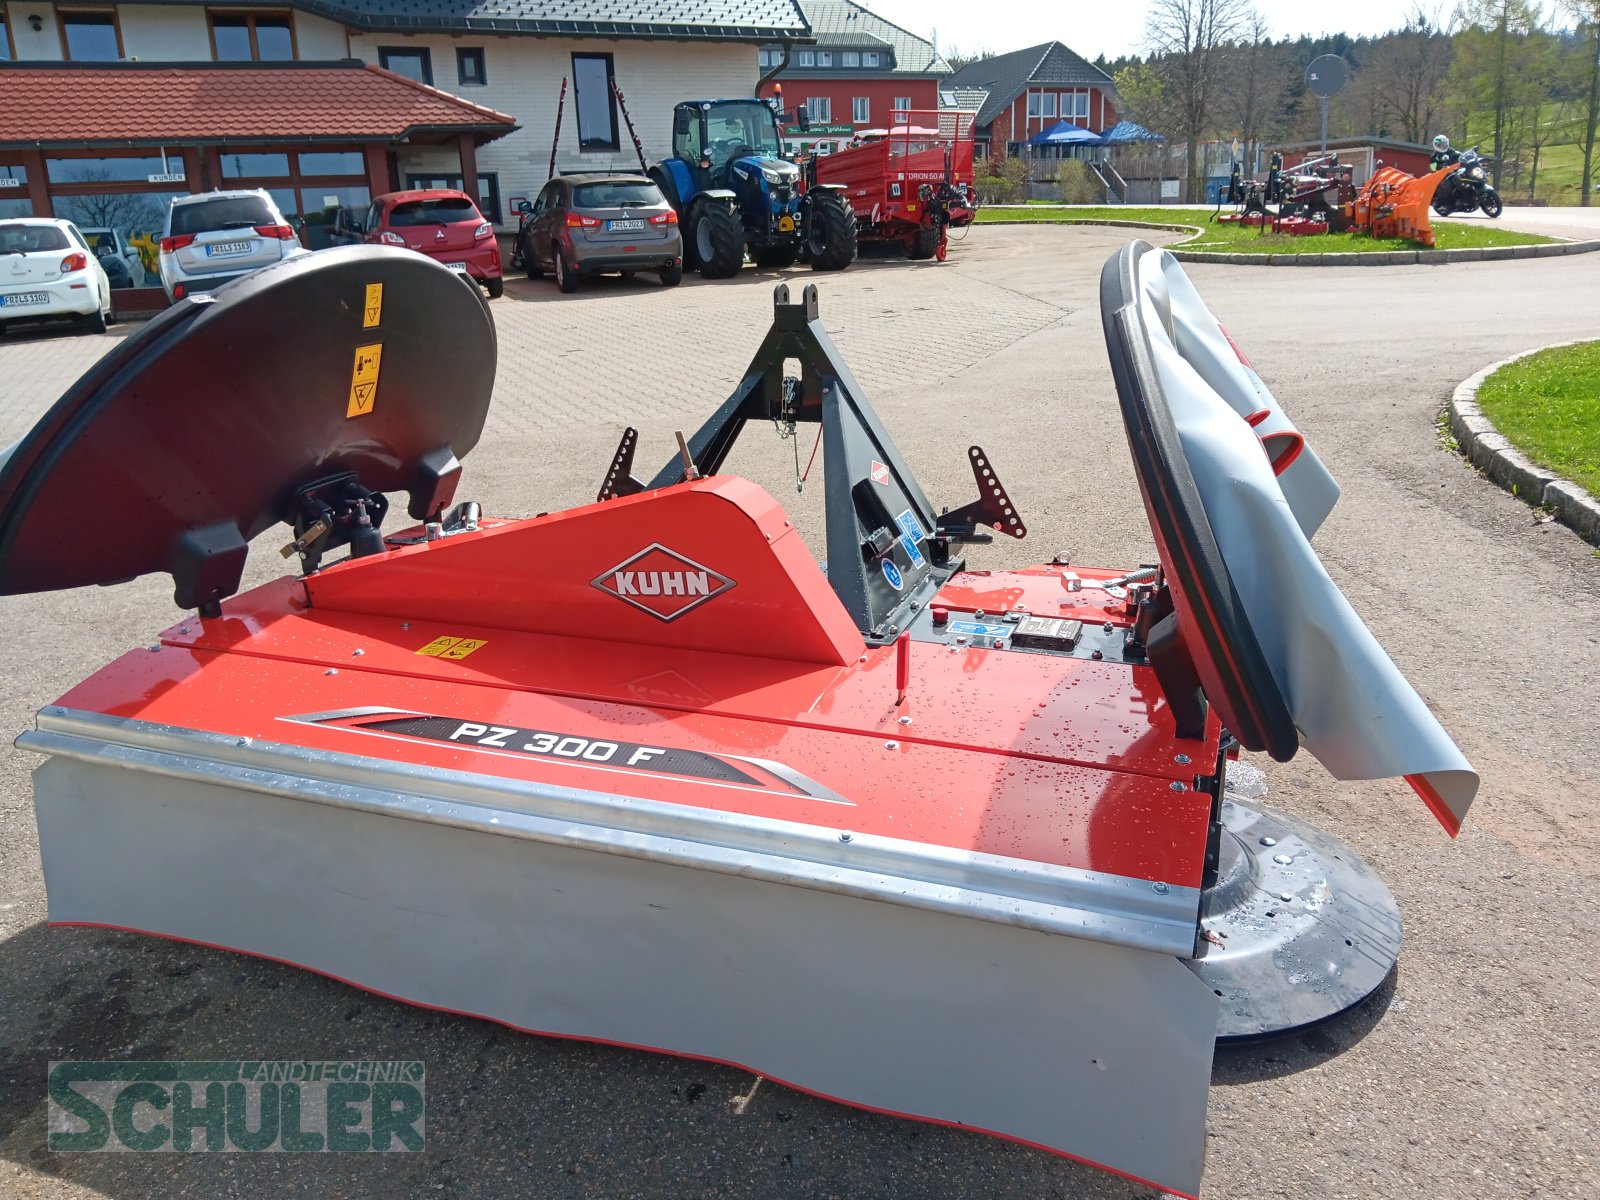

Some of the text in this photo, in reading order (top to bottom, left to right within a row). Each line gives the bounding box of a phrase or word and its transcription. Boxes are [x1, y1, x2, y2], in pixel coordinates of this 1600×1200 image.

[908, 172, 928, 180] ORION
[930, 172, 937, 180] 50
[30, 293, 47, 302] 1102
[615, 571, 710, 596] KUHN
[449, 722, 666, 766] PZ 300 F
